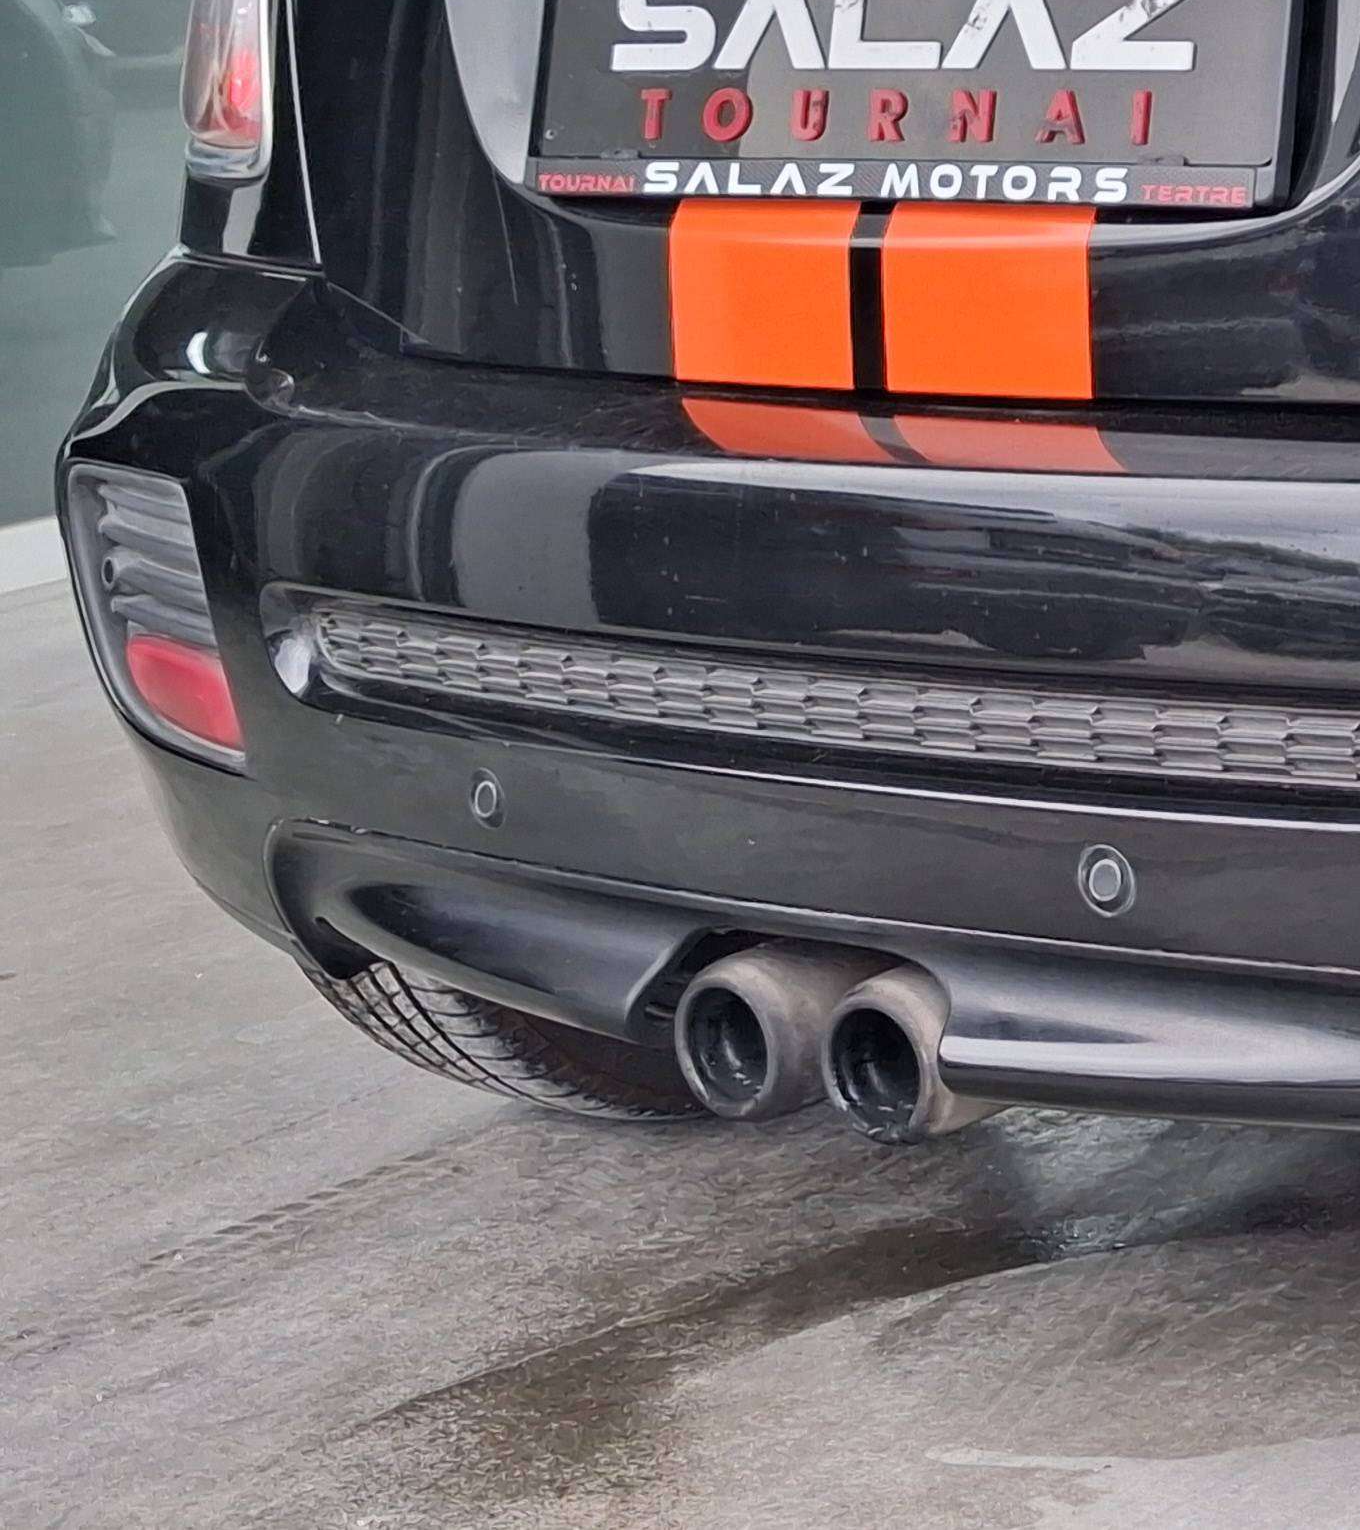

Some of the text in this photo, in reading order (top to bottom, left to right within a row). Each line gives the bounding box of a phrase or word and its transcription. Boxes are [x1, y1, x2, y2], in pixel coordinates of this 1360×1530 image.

[640, 87, 1154, 146] TOURNAI
[537, 173, 635, 193] TOURNAI
[642, 160, 1129, 203] SALAZ MOTORS
[1139, 183, 1249, 207] TERTRE
